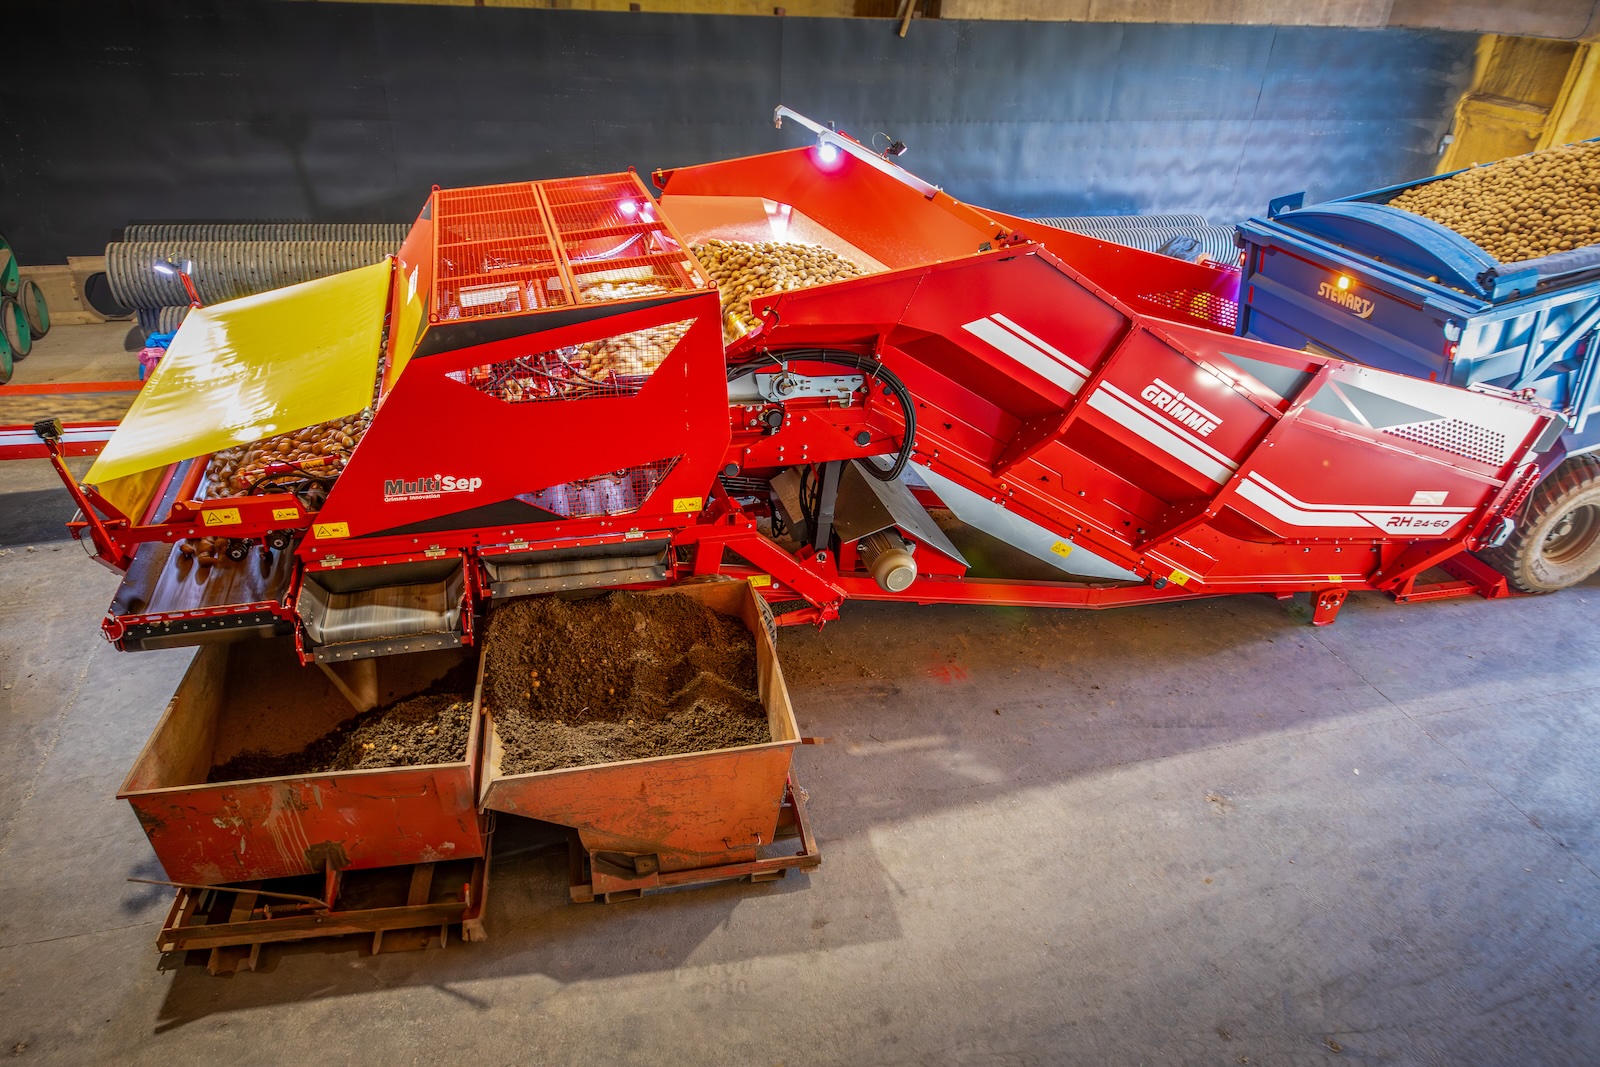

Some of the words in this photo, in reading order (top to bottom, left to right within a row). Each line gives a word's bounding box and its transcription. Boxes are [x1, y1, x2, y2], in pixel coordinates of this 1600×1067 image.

[1317, 281, 1371, 315] STEWART
[1140, 384, 1219, 438] GRIMME
[384, 474, 482, 496] MultiSep
[384, 495, 408, 503] Grimme
[409, 493, 441, 501] Innovation
[1386, 516, 1413, 527] RH
[1413, 519, 1450, 527] 24-60
